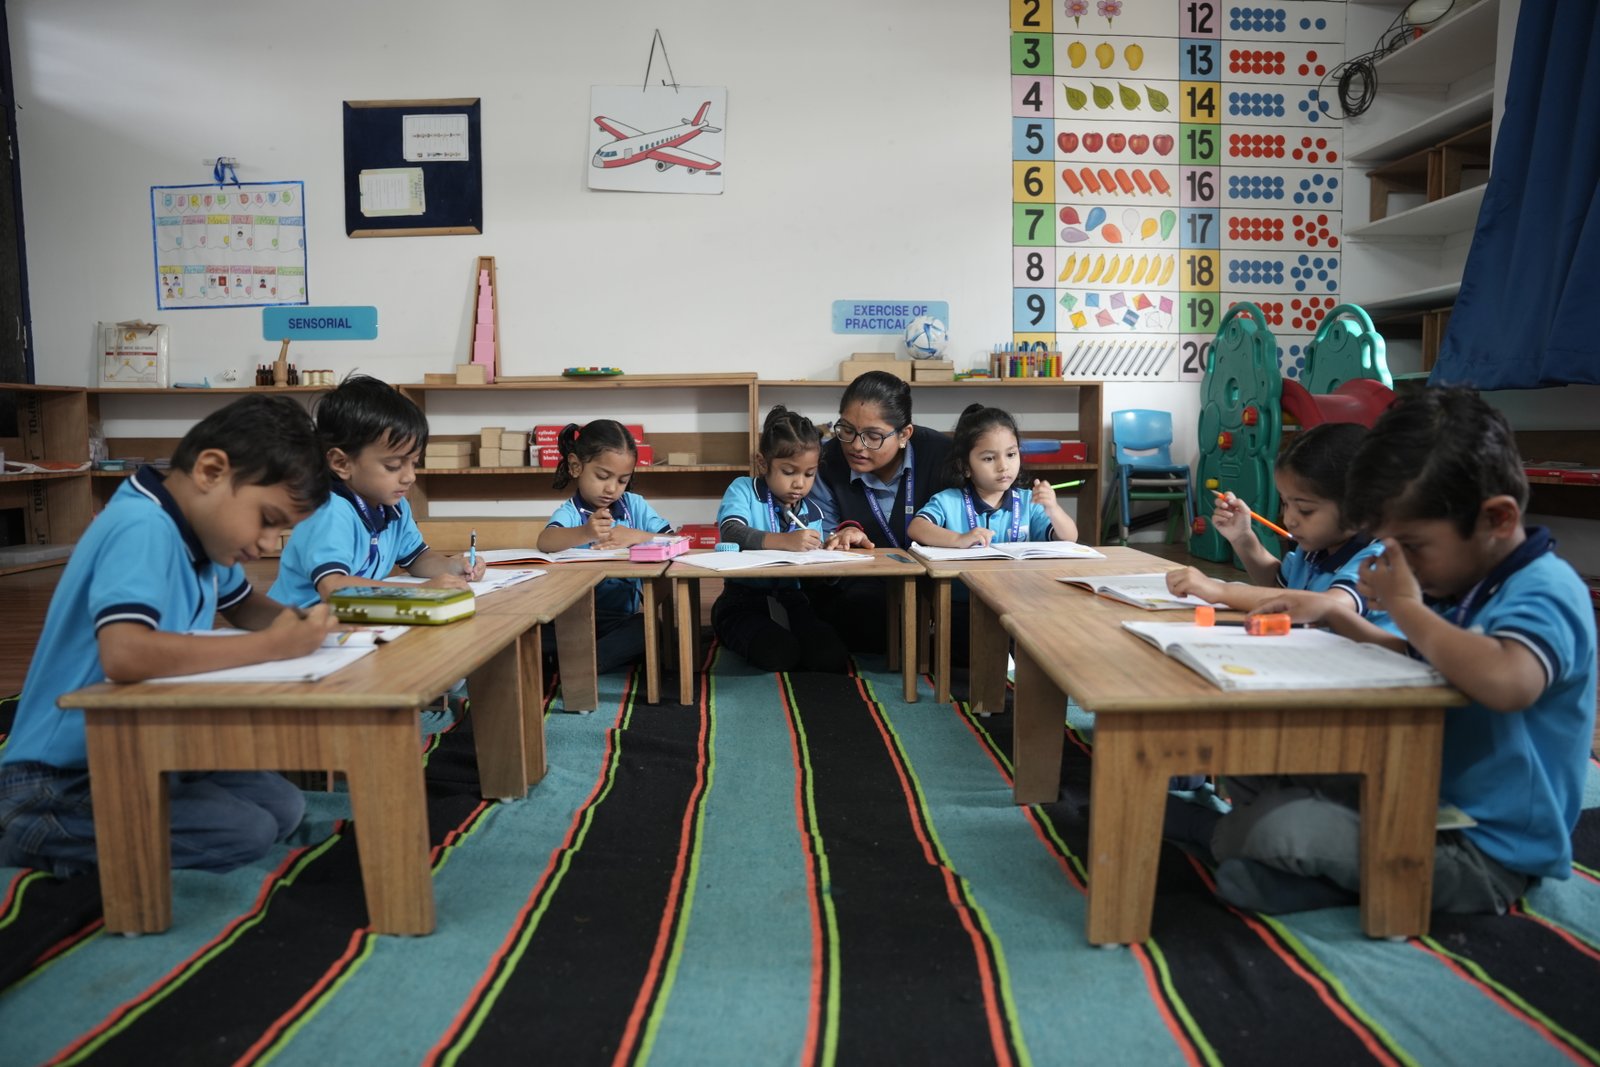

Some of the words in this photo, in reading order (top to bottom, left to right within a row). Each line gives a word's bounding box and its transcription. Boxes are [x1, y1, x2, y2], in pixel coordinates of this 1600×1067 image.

[1023, 0, 1041, 27] 2
[1187, 2, 1214, 34] 12
[1023, 38, 1041, 69] 3
[1186, 44, 1214, 75] 13
[1022, 82, 1042, 112] 4
[1186, 87, 1216, 118] 14
[1025, 124, 1044, 155] 5
[1186, 129, 1214, 160] 15
[1024, 166, 1043, 196] 6
[1186, 171, 1214, 202] 16
[1025, 209, 1045, 240] 7
[1187, 213, 1214, 244] 17
[1026, 252, 1044, 282] 8
[1187, 255, 1214, 286] 18
[288, 317, 352, 329] SENSORIAL
[845, 318, 906, 330] PRACTICAL
[853, 305, 909, 316] EXERCISE
[912, 305, 928, 317] OF
[1026, 294, 1046, 326] 9
[1187, 297, 1214, 328] 19
